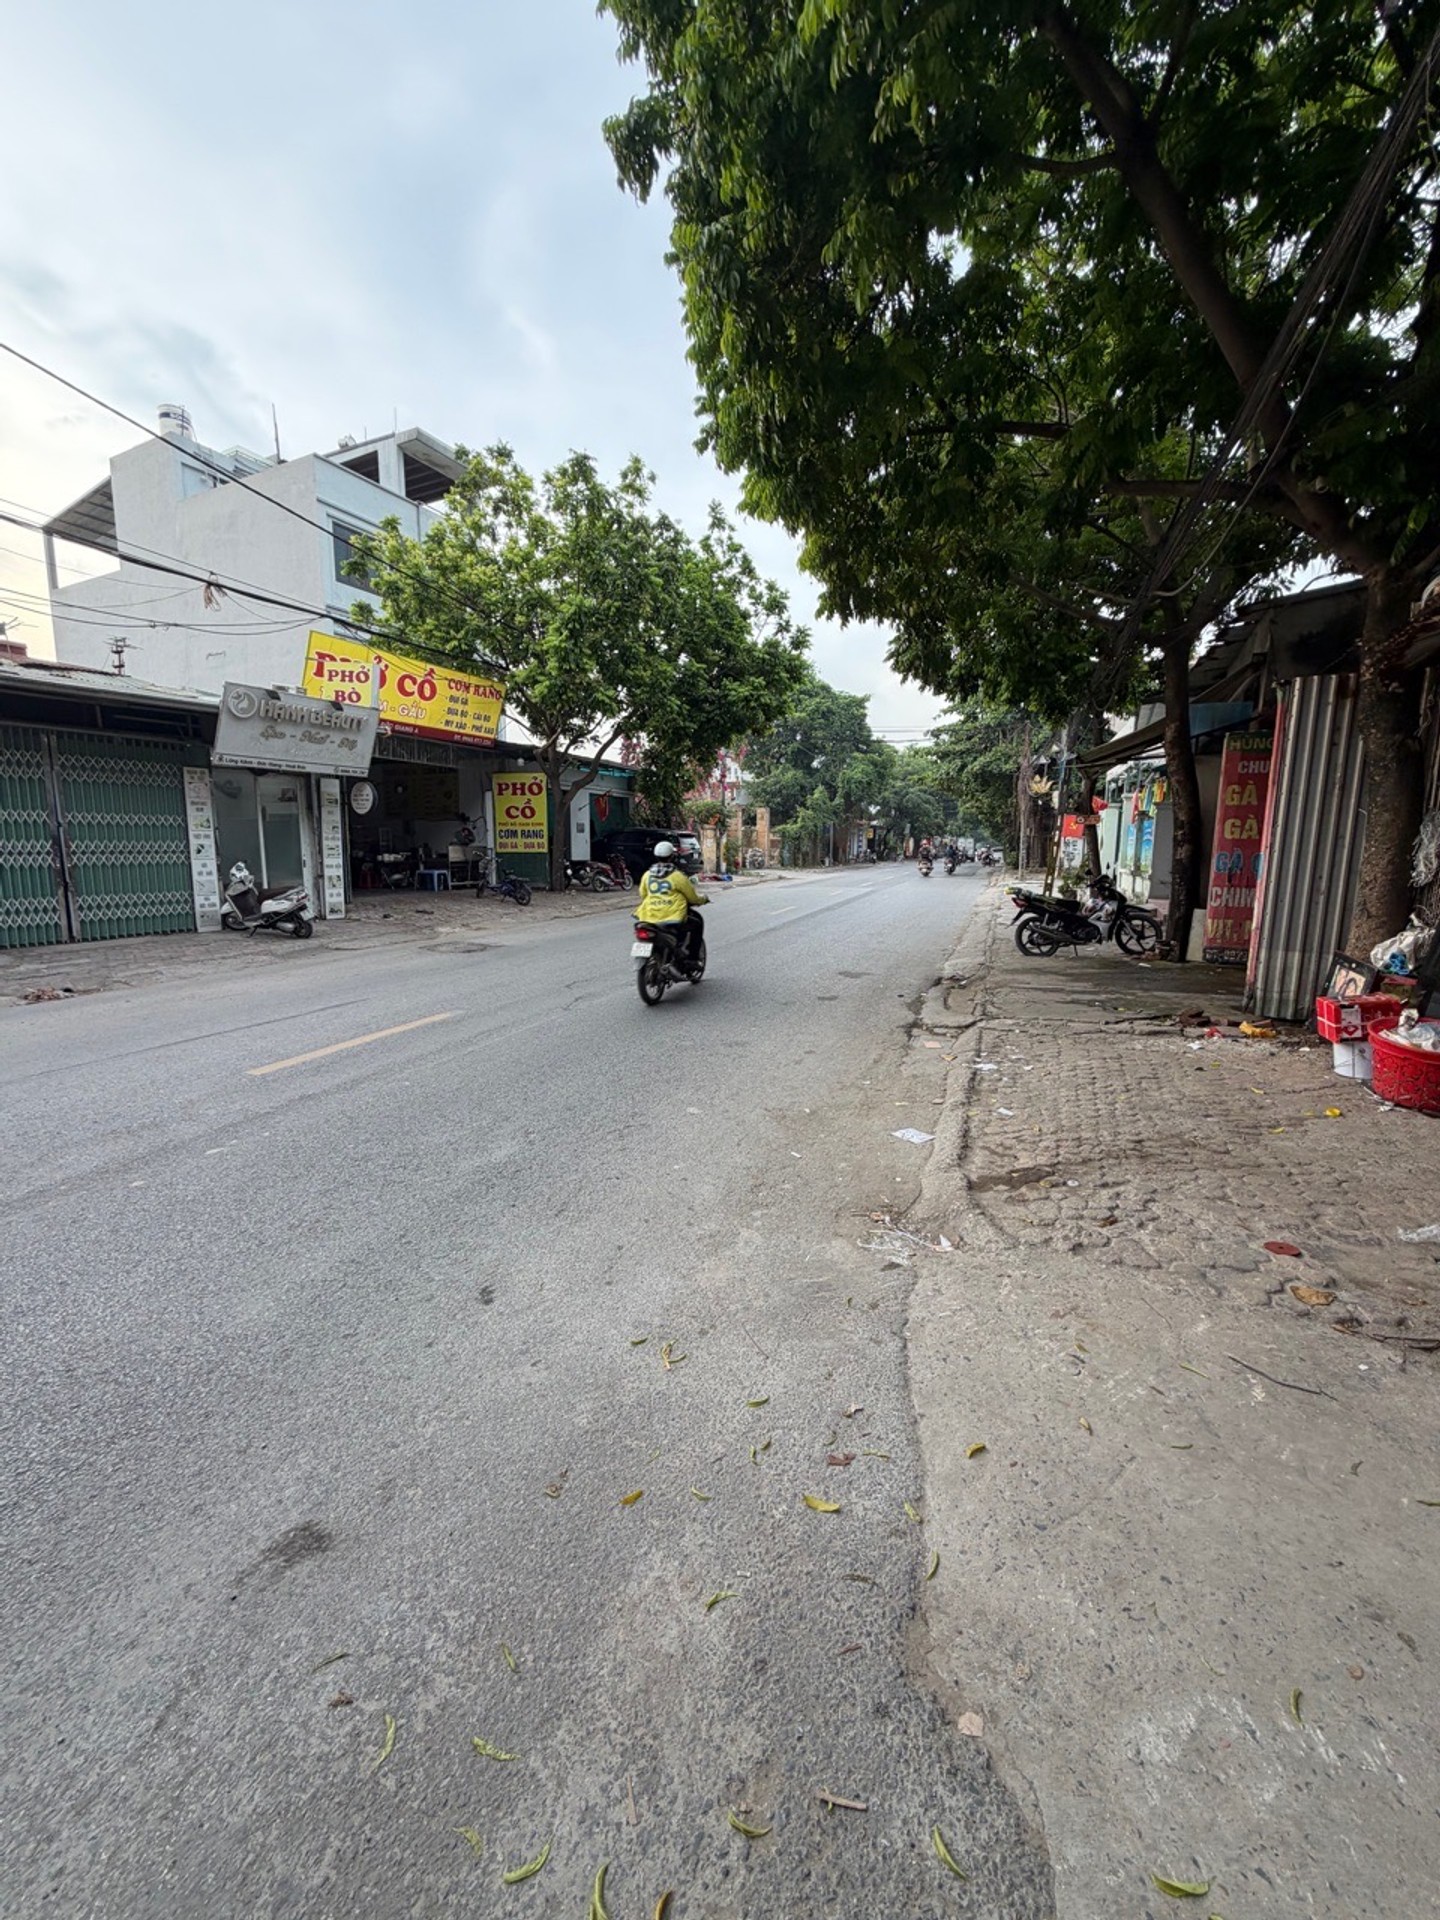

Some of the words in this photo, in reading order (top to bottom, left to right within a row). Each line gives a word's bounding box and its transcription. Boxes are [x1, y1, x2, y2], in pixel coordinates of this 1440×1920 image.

[327, 665, 370, 683] PHỞ
[334, 687, 361, 703] BÒ
[1238, 760, 1270, 774] CHU
[496, 775, 543, 796] PHỞ
[1225, 780, 1258, 806] GÀ
[520, 829, 544, 839] RANG
[1223, 814, 1259, 839] GÀ
